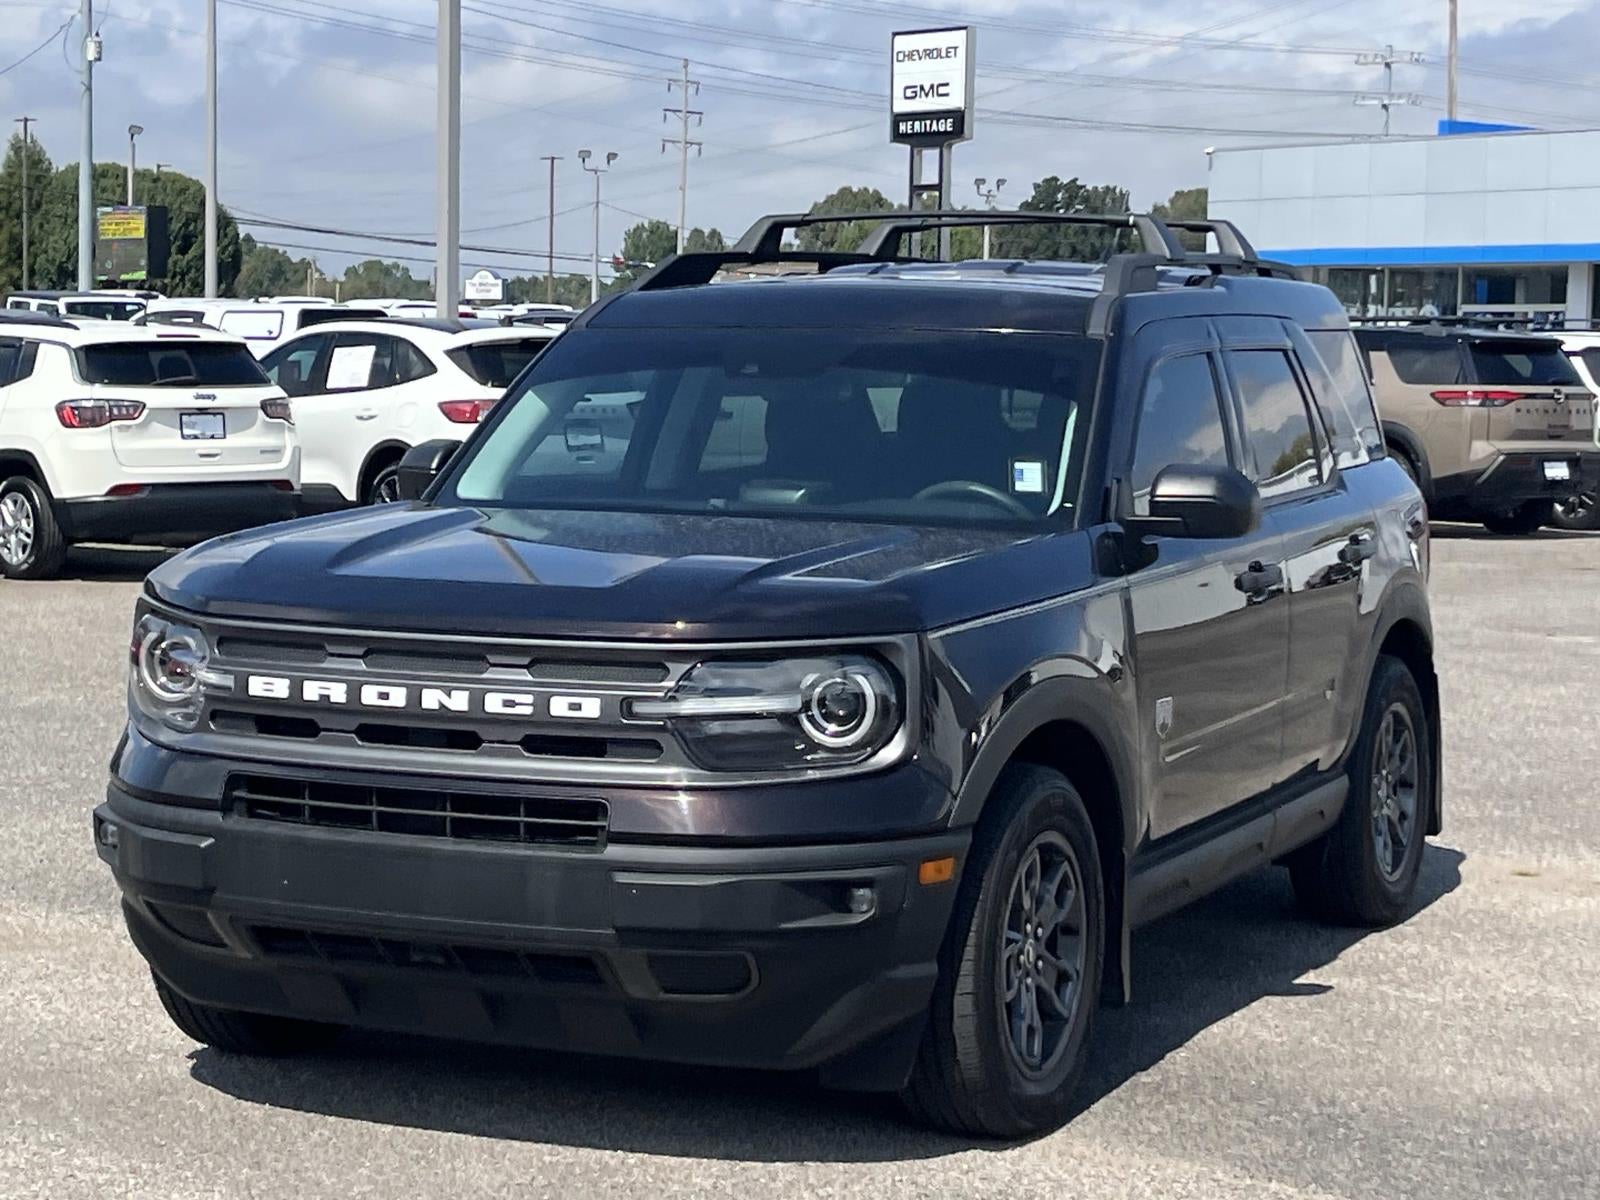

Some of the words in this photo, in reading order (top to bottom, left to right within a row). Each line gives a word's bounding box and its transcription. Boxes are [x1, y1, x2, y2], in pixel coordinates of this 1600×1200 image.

[896, 46, 959, 62] CHEVROLET
[903, 82, 950, 100] GMC
[899, 118, 954, 134] HERITAGE
[247, 674, 601, 719] BRONCO
